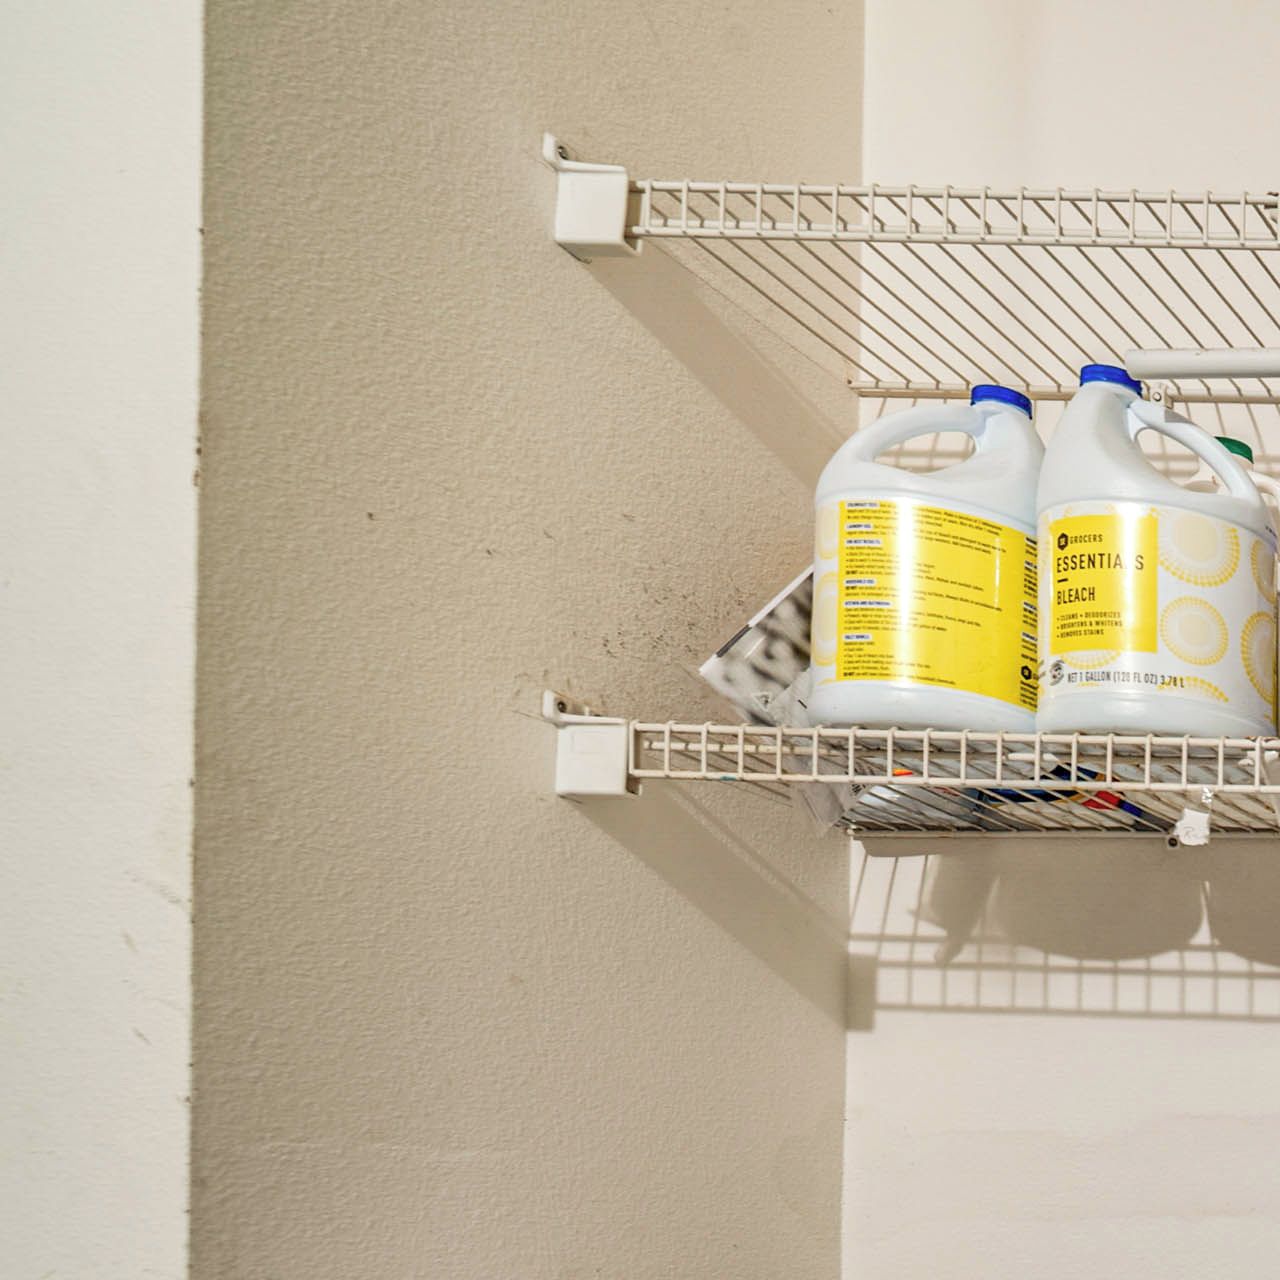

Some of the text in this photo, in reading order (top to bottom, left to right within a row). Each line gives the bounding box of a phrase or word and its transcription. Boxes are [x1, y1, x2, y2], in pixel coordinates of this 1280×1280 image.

[1069, 534, 1103, 544] GROCERS
[1056, 552, 1145, 574] ESSENTIAS
[1057, 586, 1096, 605] BLEACH
[1085, 671, 1111, 683] GALLON
[1133, 672, 1142, 683] FL
